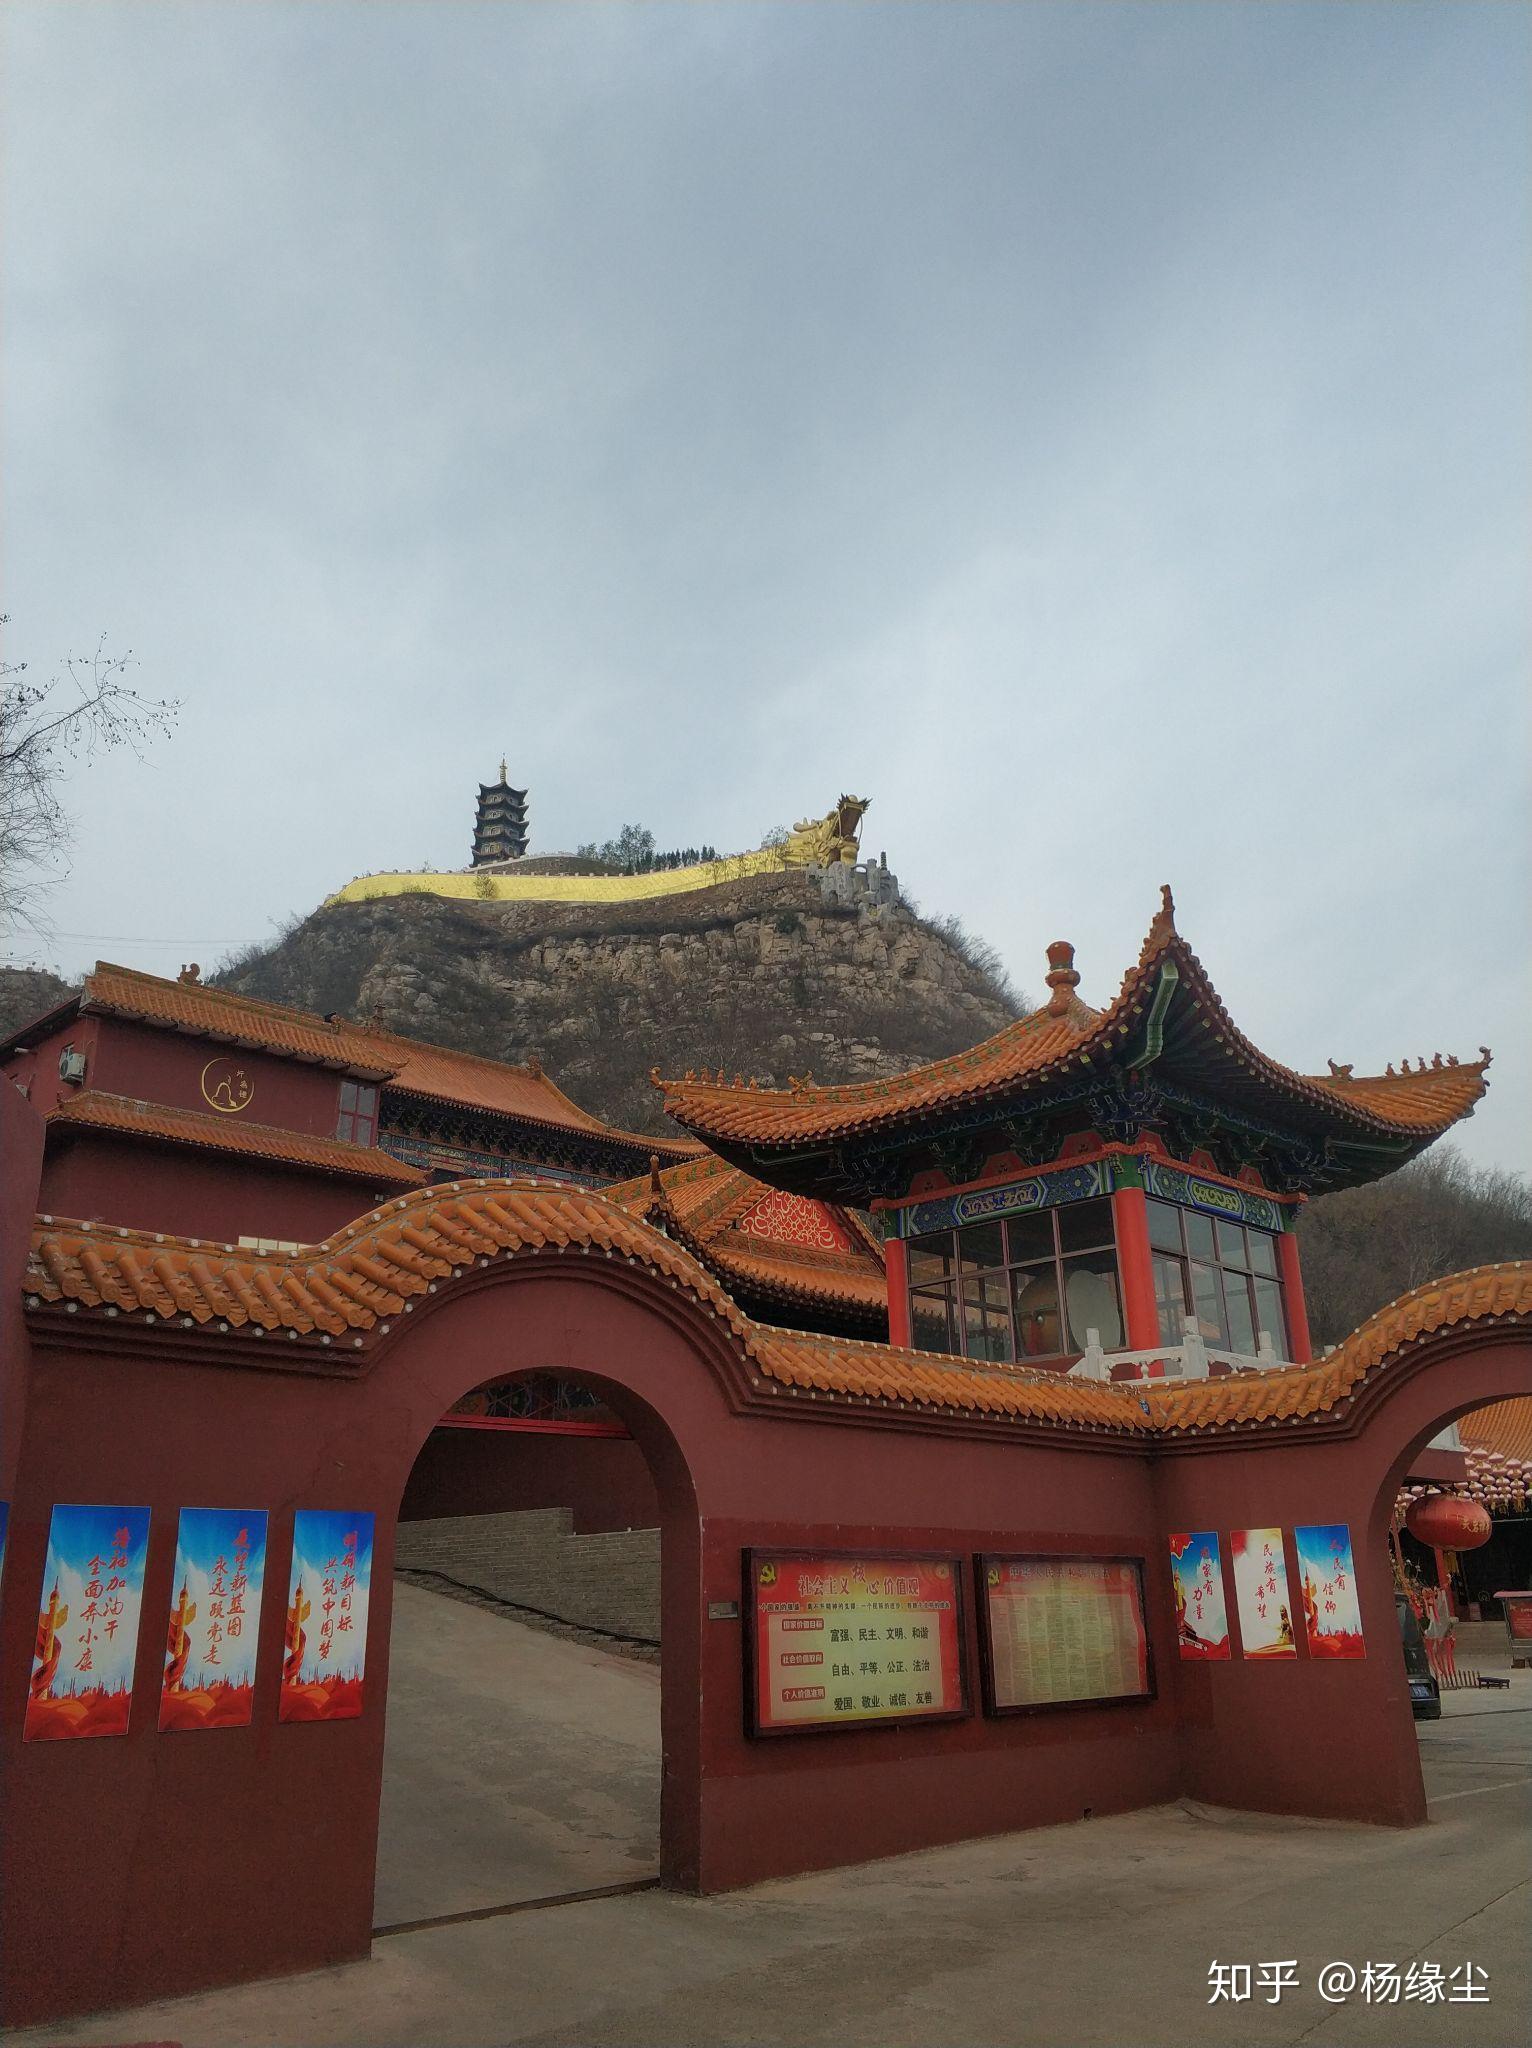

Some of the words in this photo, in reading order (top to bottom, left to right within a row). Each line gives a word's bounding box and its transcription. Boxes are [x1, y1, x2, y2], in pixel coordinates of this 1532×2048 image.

[227, 1528, 251, 1637] 展望新蓝图
[798, 1563, 920, 1597] 社会主义核心价值观
[1263, 1543, 1277, 1594] 民族有
[1328, 1539, 1346, 1591] 人民有
[74, 1555, 107, 1672] 全面奔小康
[203, 1555, 229, 1665] 永远跟党走
[319, 1556, 338, 1661] 共筑中国梦
[1192, 1587, 1205, 1620] 力量
[1254, 1584, 1268, 1619] 希望
[1322, 1582, 1337, 1615] 信仰
[830, 1626, 929, 1643] 富强、民主、文明、和谐
[832, 1660, 930, 1677] 自由、平等、公正、法治
[834, 1691, 933, 1711] 爱国、敬业、诚信、友善
